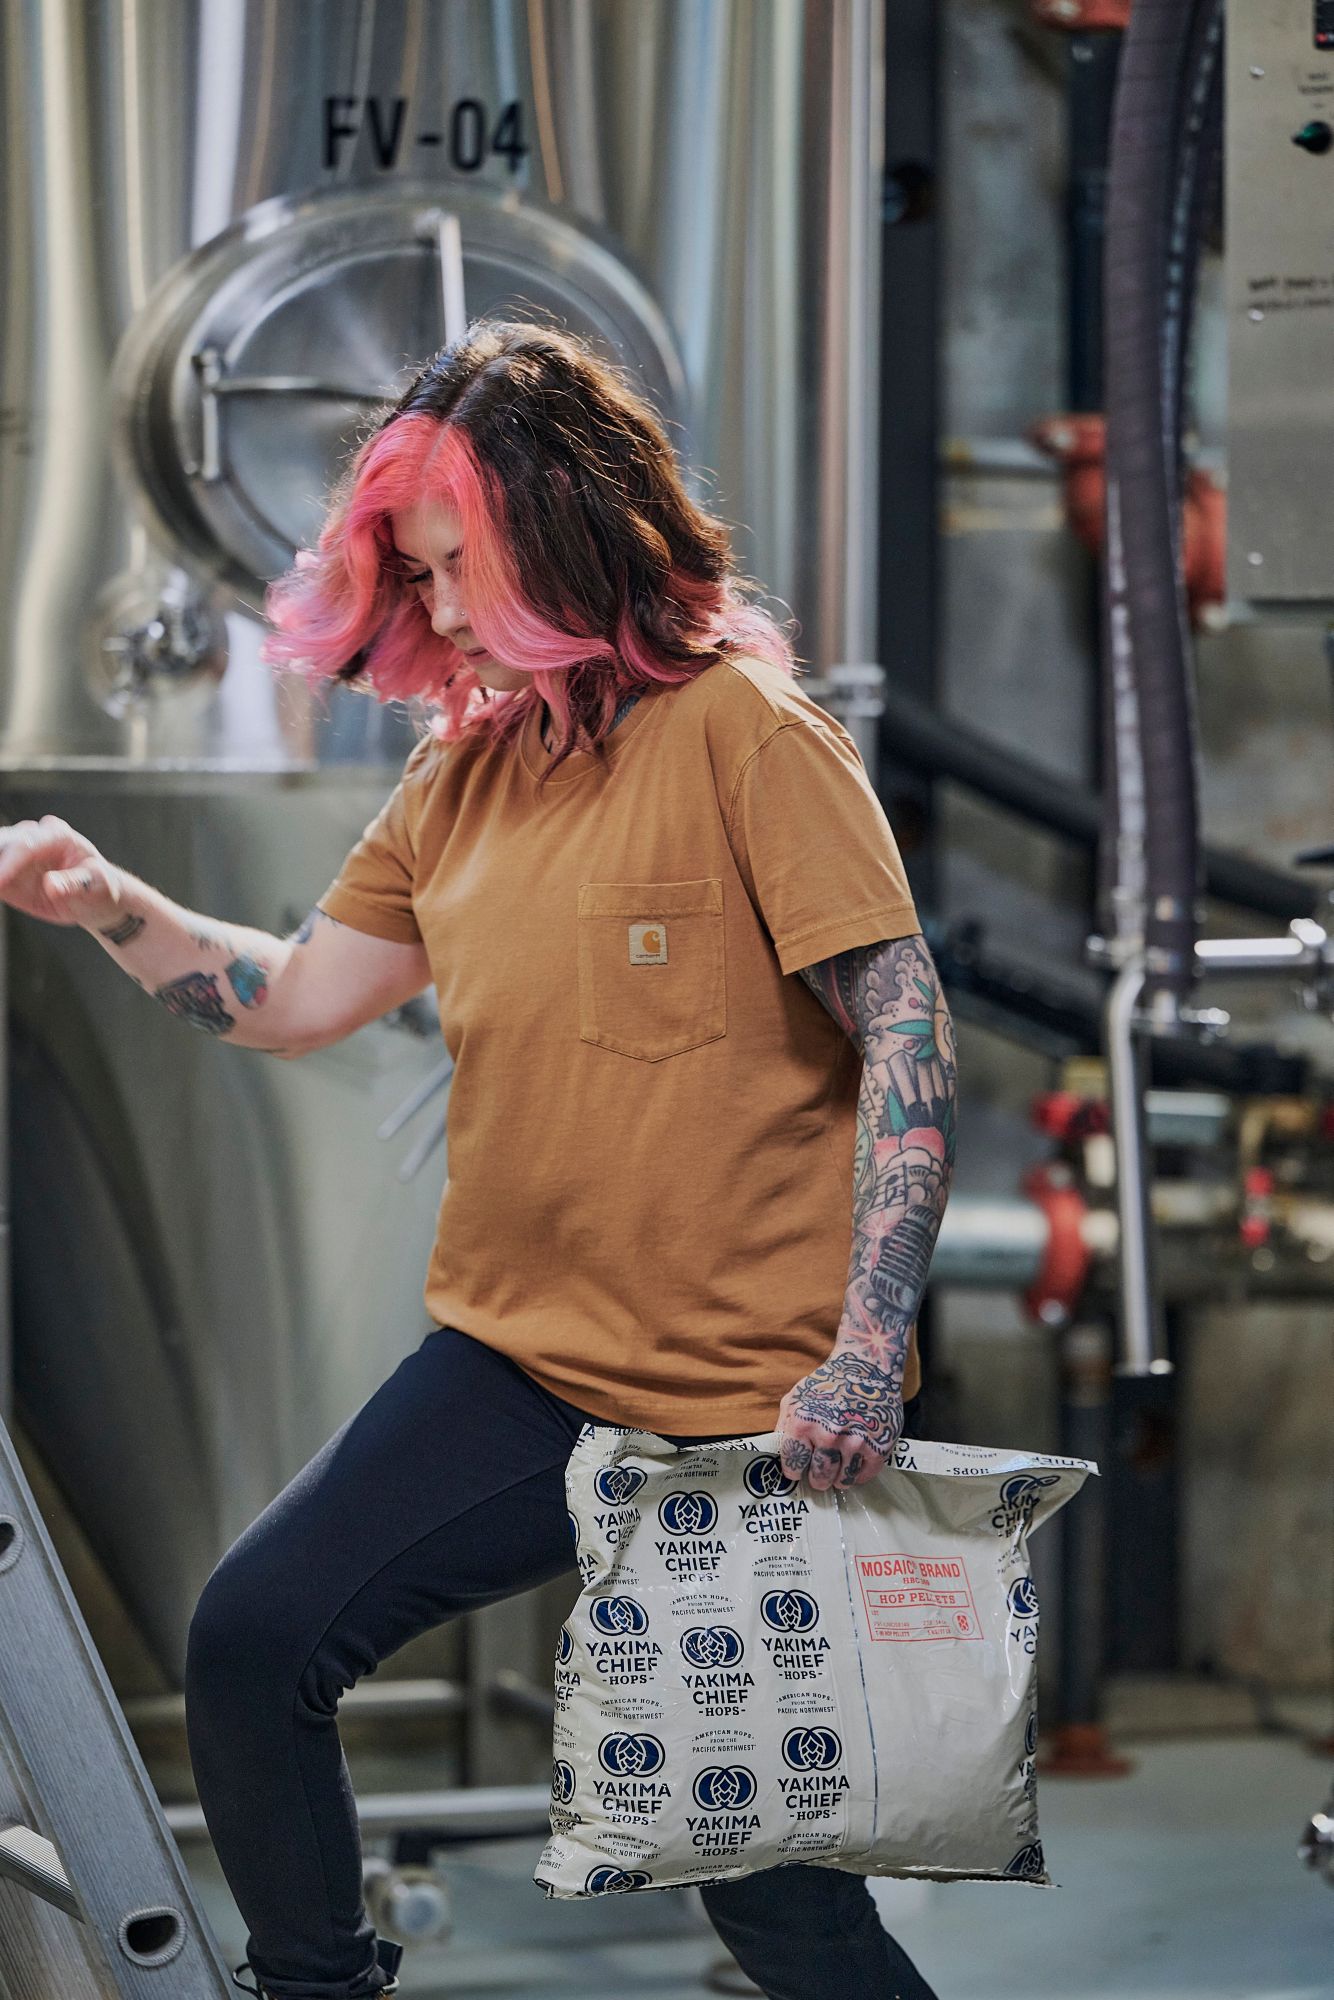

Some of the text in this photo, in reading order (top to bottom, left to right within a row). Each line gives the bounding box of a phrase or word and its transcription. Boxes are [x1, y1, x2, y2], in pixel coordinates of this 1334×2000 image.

[322, 97, 526, 174] FV-04
[738, 1500, 809, 1519] YAKIMA
[593, 1508, 641, 1529] YAKIMA
[746, 1517, 802, 1534] CHIEF
[655, 1541, 727, 1556] YAKIMA
[665, 1557, 721, 1572] CHIEF
[754, 1555, 807, 1566] AMERICAN HOPS
[919, 1562, 960, 1578] BRAND
[672, 1594, 729, 1606] AMERICAN HOPS
[880, 1592, 956, 1605] HOP PELLETS
[586, 1641, 662, 1656] YAKIMA
[761, 1637, 831, 1652] YAKIMA
[596, 1657, 658, 1673] CHIEF
[773, 1654, 824, 1668] CHIEF
[681, 1672, 755, 1688] YAKIMA
[602, 1698, 659, 1707] AMERICAN HOPS
[693, 1690, 748, 1704] CHIEF
[778, 1692, 830, 1702] AMERICAN HOPS
[600, 1711, 622, 1719] PACIFIC
[799, 1706, 834, 1714] NORTHWEST
[695, 1730, 752, 1741] AMERICAN HOPS
[717, 1744, 754, 1752] NORTHWEST
[593, 1780, 671, 1797] YAKIMA
[777, 1775, 850, 1792] YAKIMA
[602, 1797, 663, 1814] CHIEF
[785, 1793, 842, 1809] CHIEF
[686, 1815, 761, 1831] YAKIMA
[598, 1833, 658, 1849] AMERICAN HOPS
[692, 1832, 752, 1846] CHIEF
[782, 1833, 819, 1844] AMERICAN
[618, 1849, 659, 1860] NORTHWEST
